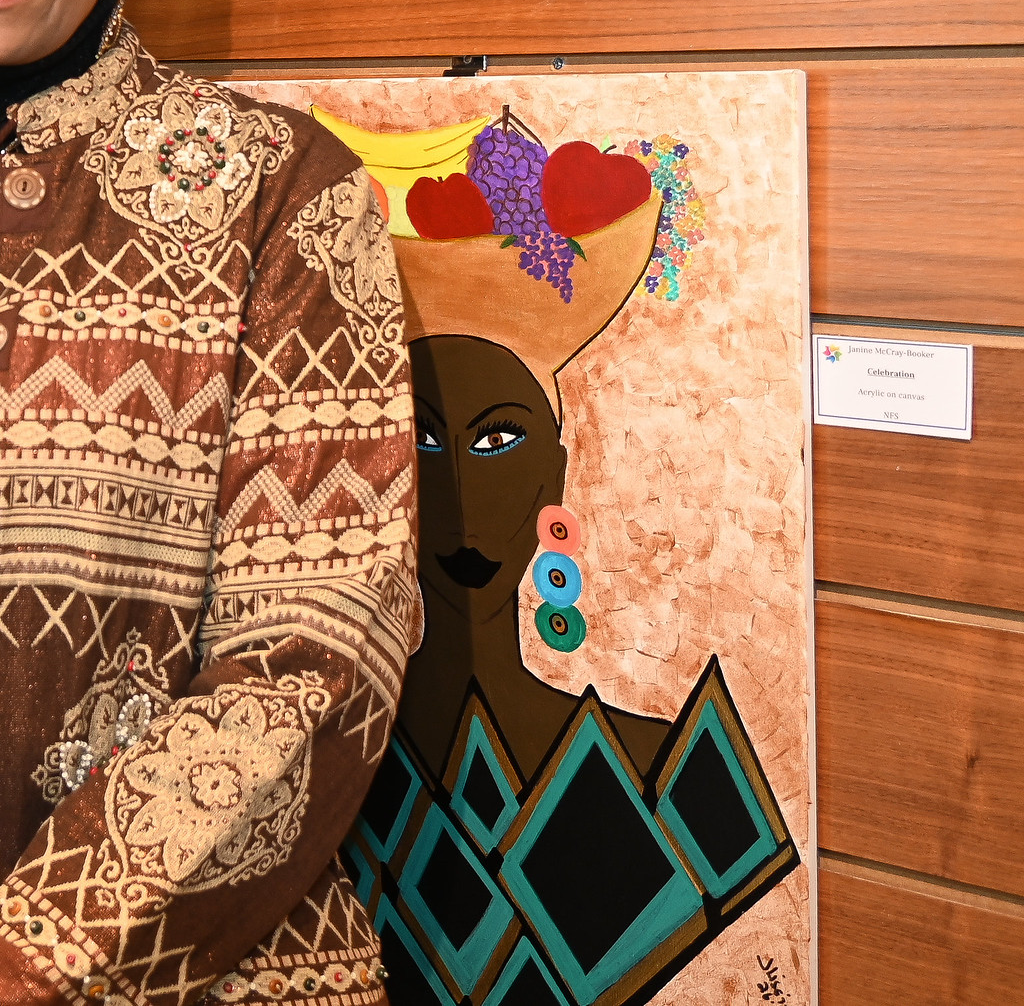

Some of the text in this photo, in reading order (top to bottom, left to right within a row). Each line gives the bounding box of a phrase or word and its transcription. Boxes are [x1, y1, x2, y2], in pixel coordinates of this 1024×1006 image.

[848, 345, 935, 359] Janine McCray-Booker
[867, 367, 915, 379] Celebration
[858, 388, 885, 399] Acrylic
[898, 393, 925, 401] canvas
[883, 411, 899, 419] NFS
